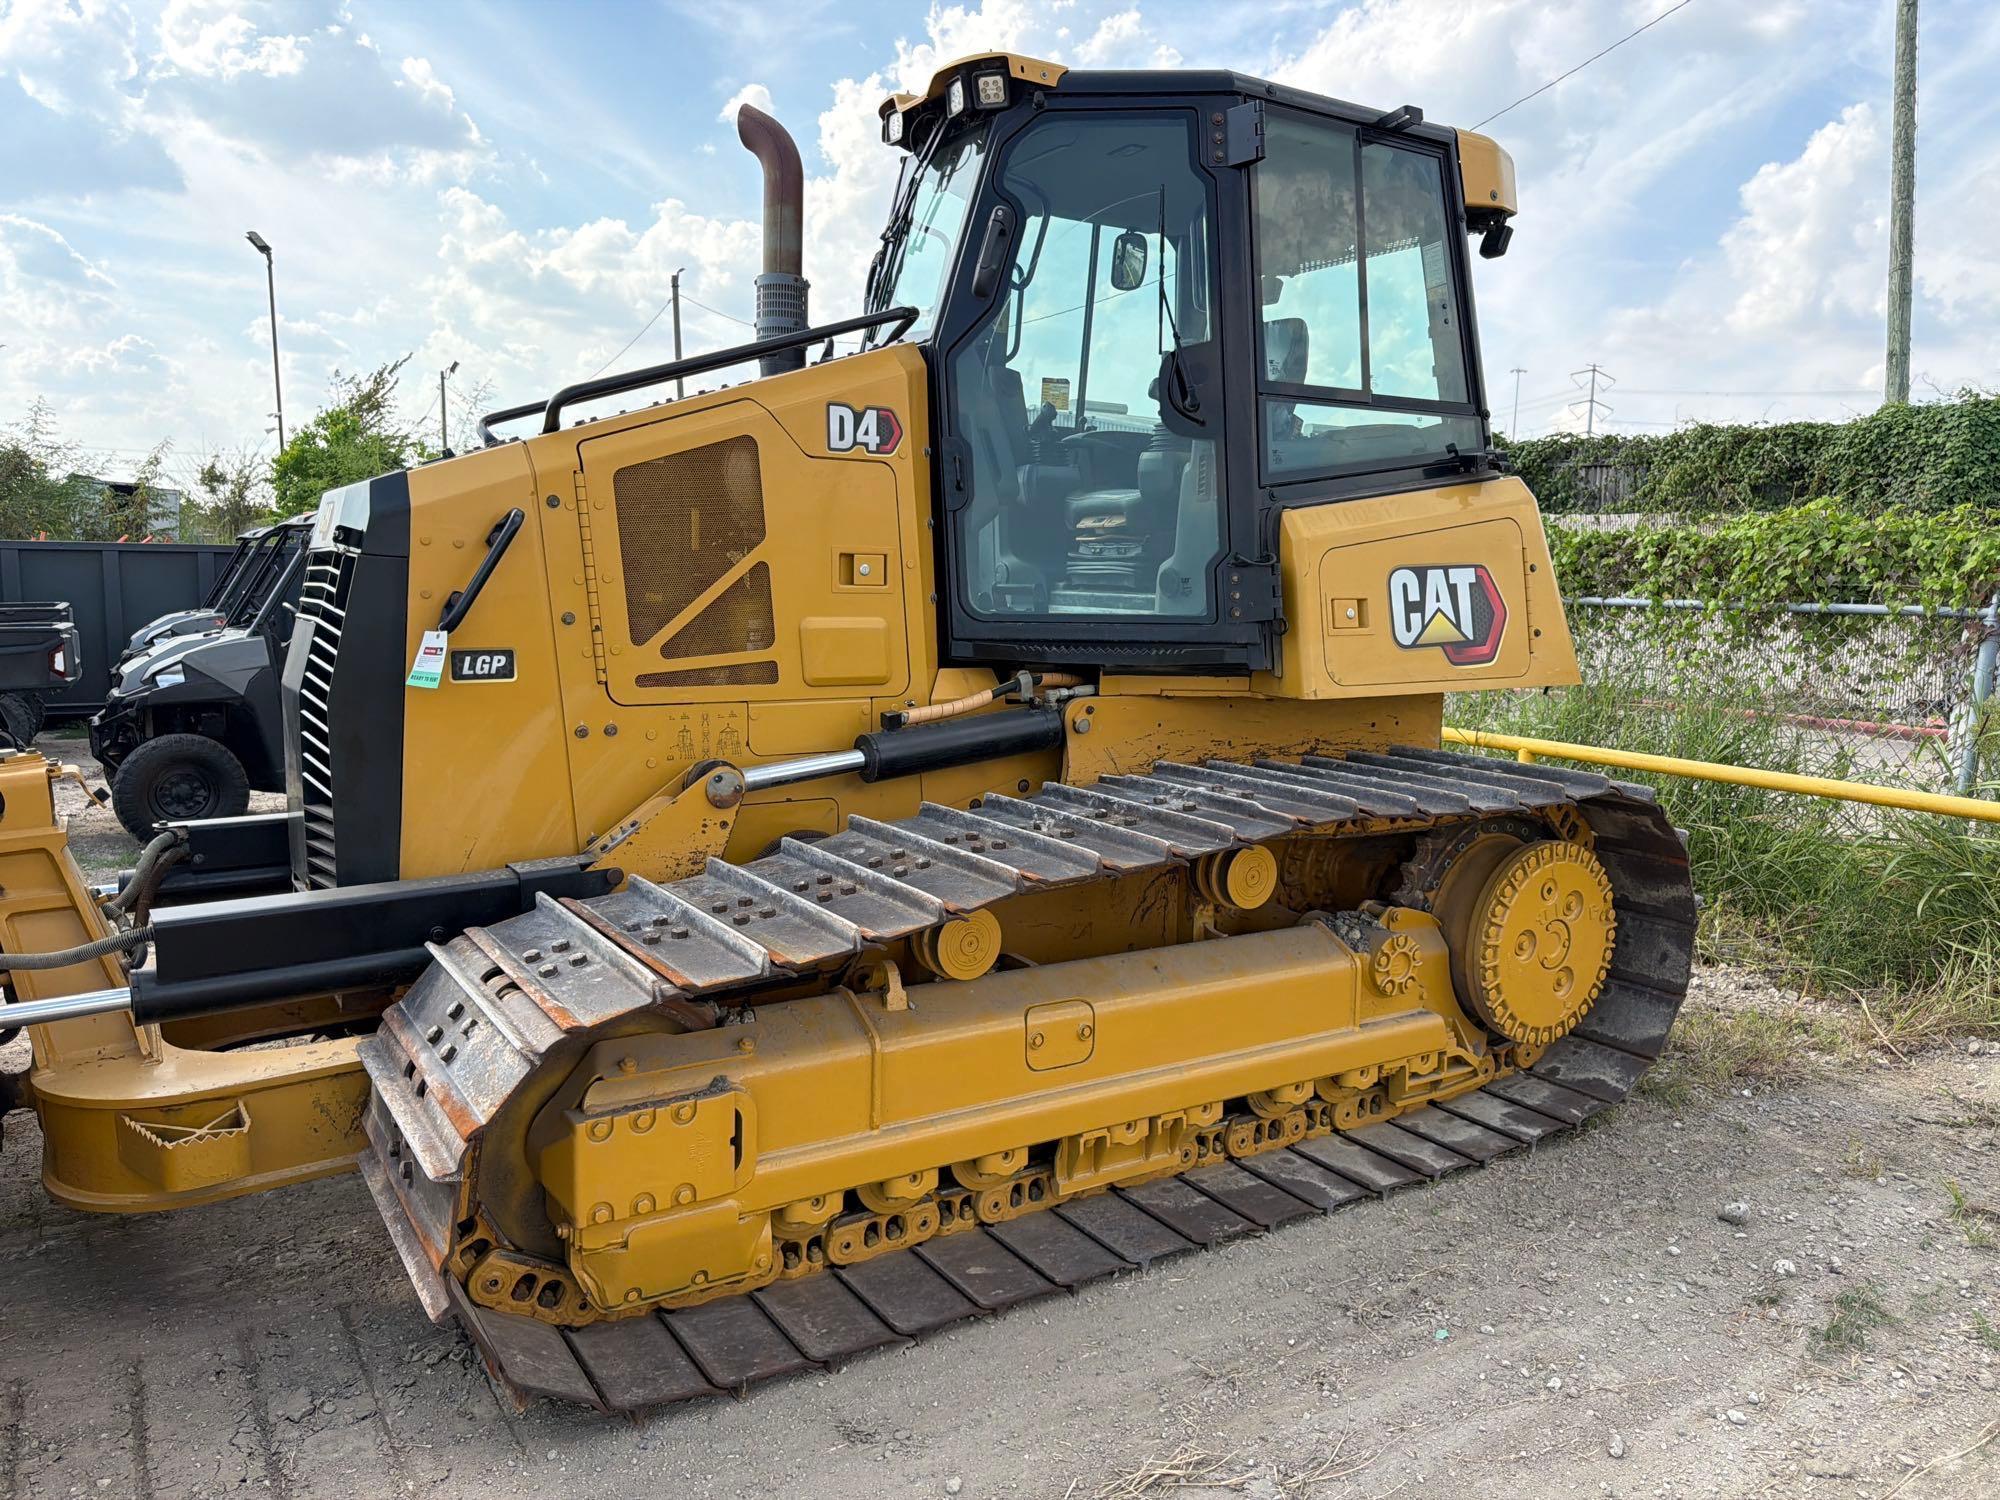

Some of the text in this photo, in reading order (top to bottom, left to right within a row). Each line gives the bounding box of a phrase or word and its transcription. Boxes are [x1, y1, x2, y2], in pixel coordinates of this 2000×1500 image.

[829, 405, 880, 451] D4
[1390, 567, 1476, 645] CAT
[462, 655, 506, 675] LGP
